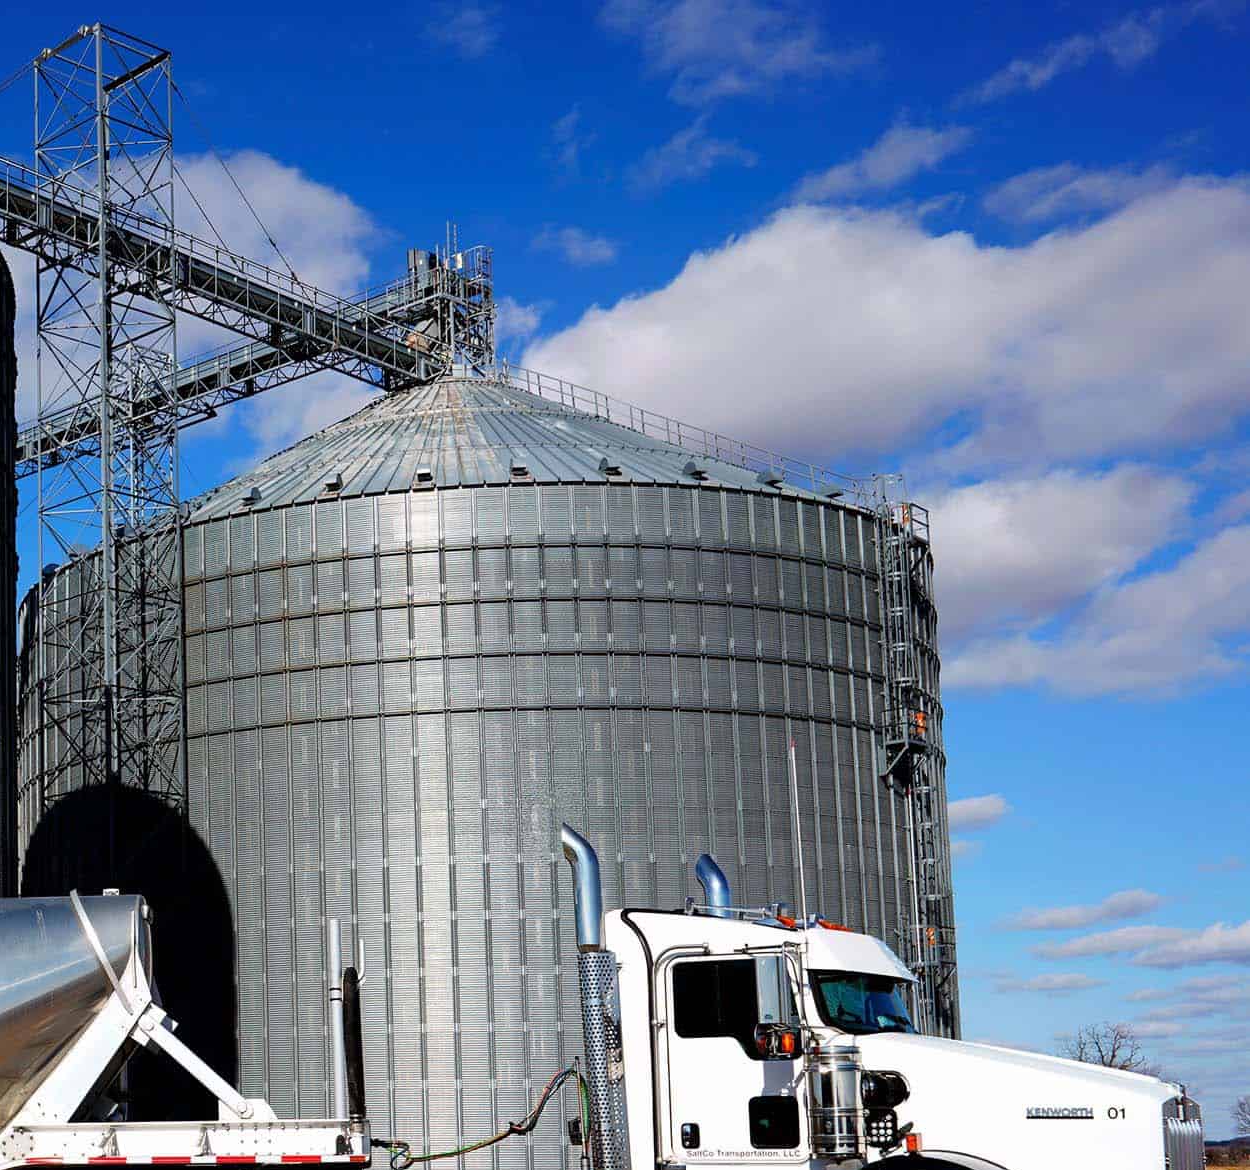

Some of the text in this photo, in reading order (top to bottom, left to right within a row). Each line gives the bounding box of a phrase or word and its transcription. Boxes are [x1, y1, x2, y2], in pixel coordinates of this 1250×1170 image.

[1025, 1107, 1094, 1118] KENWORTH
[686, 1150, 714, 1158] SaltCo
[783, 1150, 801, 1158] LLC
